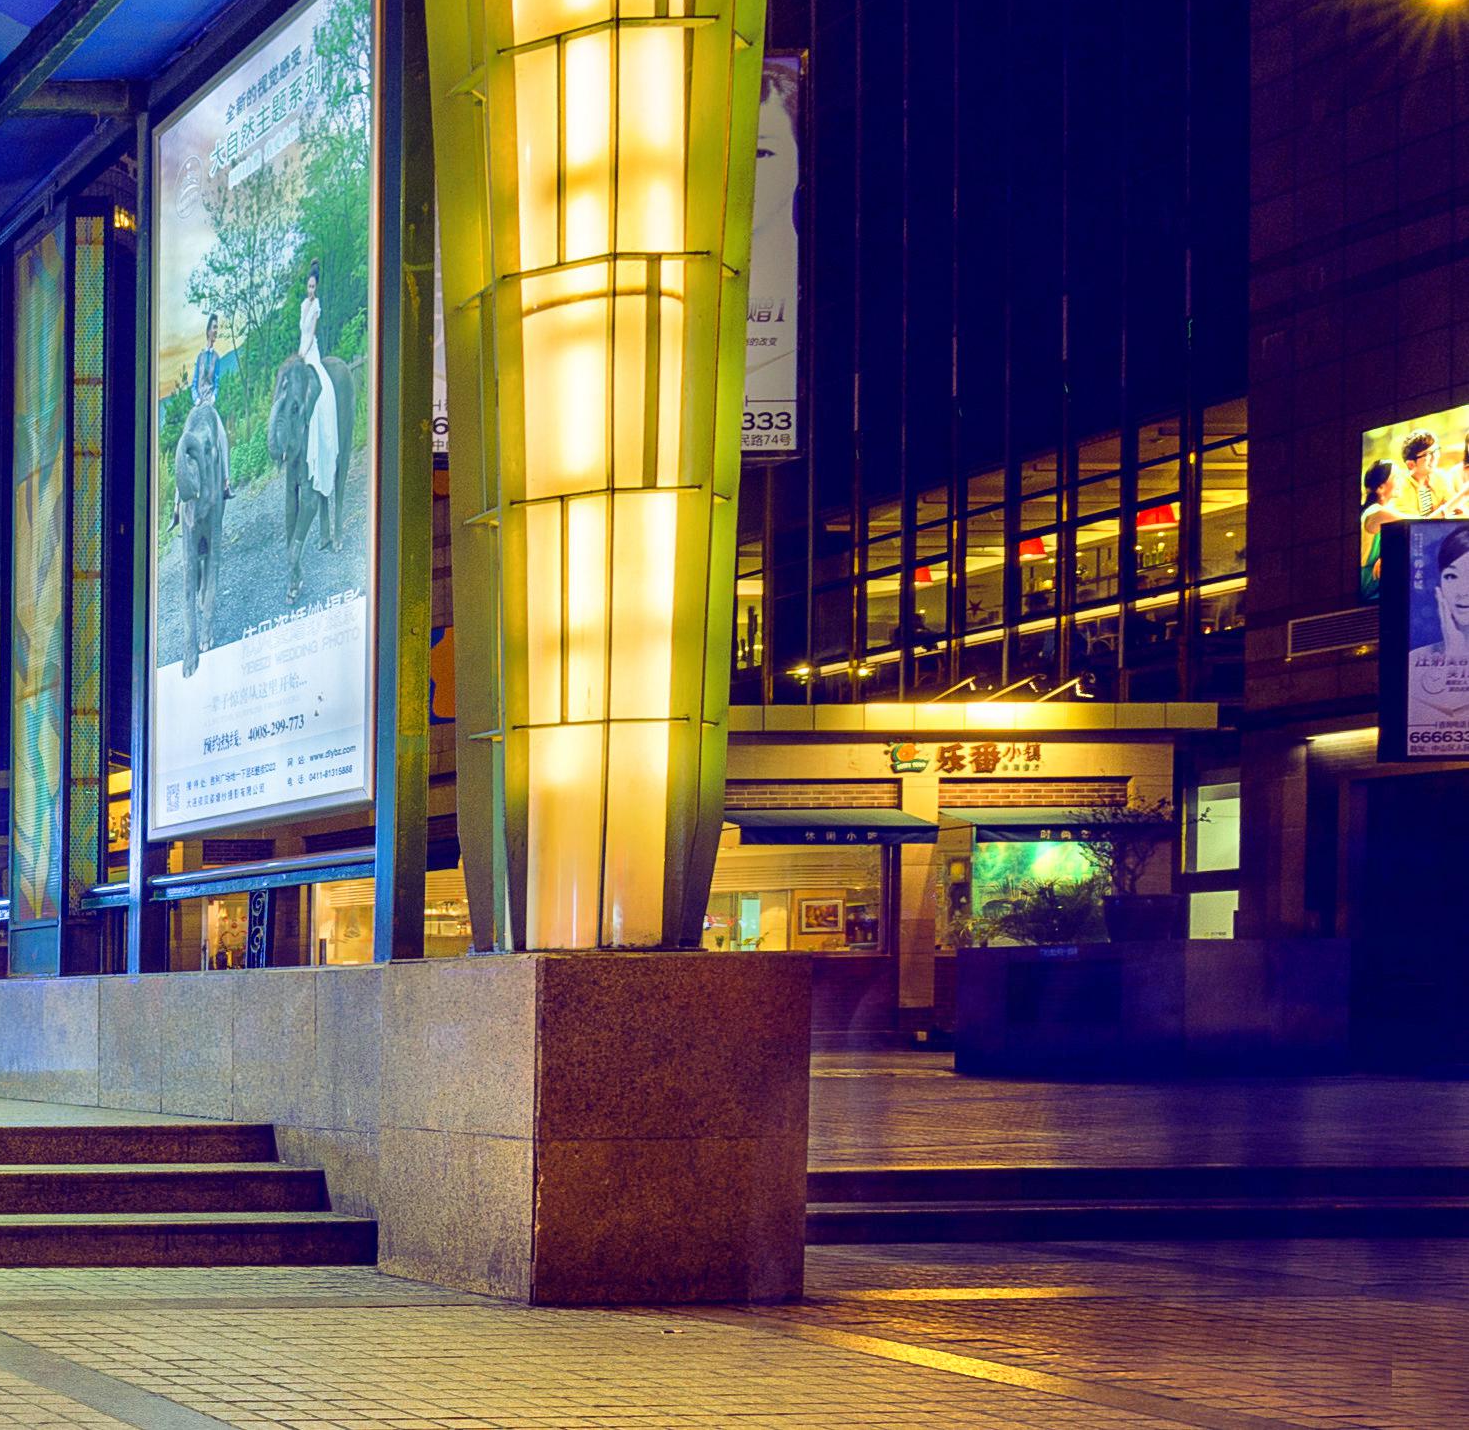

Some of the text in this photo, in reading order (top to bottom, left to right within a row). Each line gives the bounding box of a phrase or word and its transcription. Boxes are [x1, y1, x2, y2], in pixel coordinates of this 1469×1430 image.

[209, 56, 323, 178] 大自然主题系列
[248, 714, 306, 743] 4008-299-773
